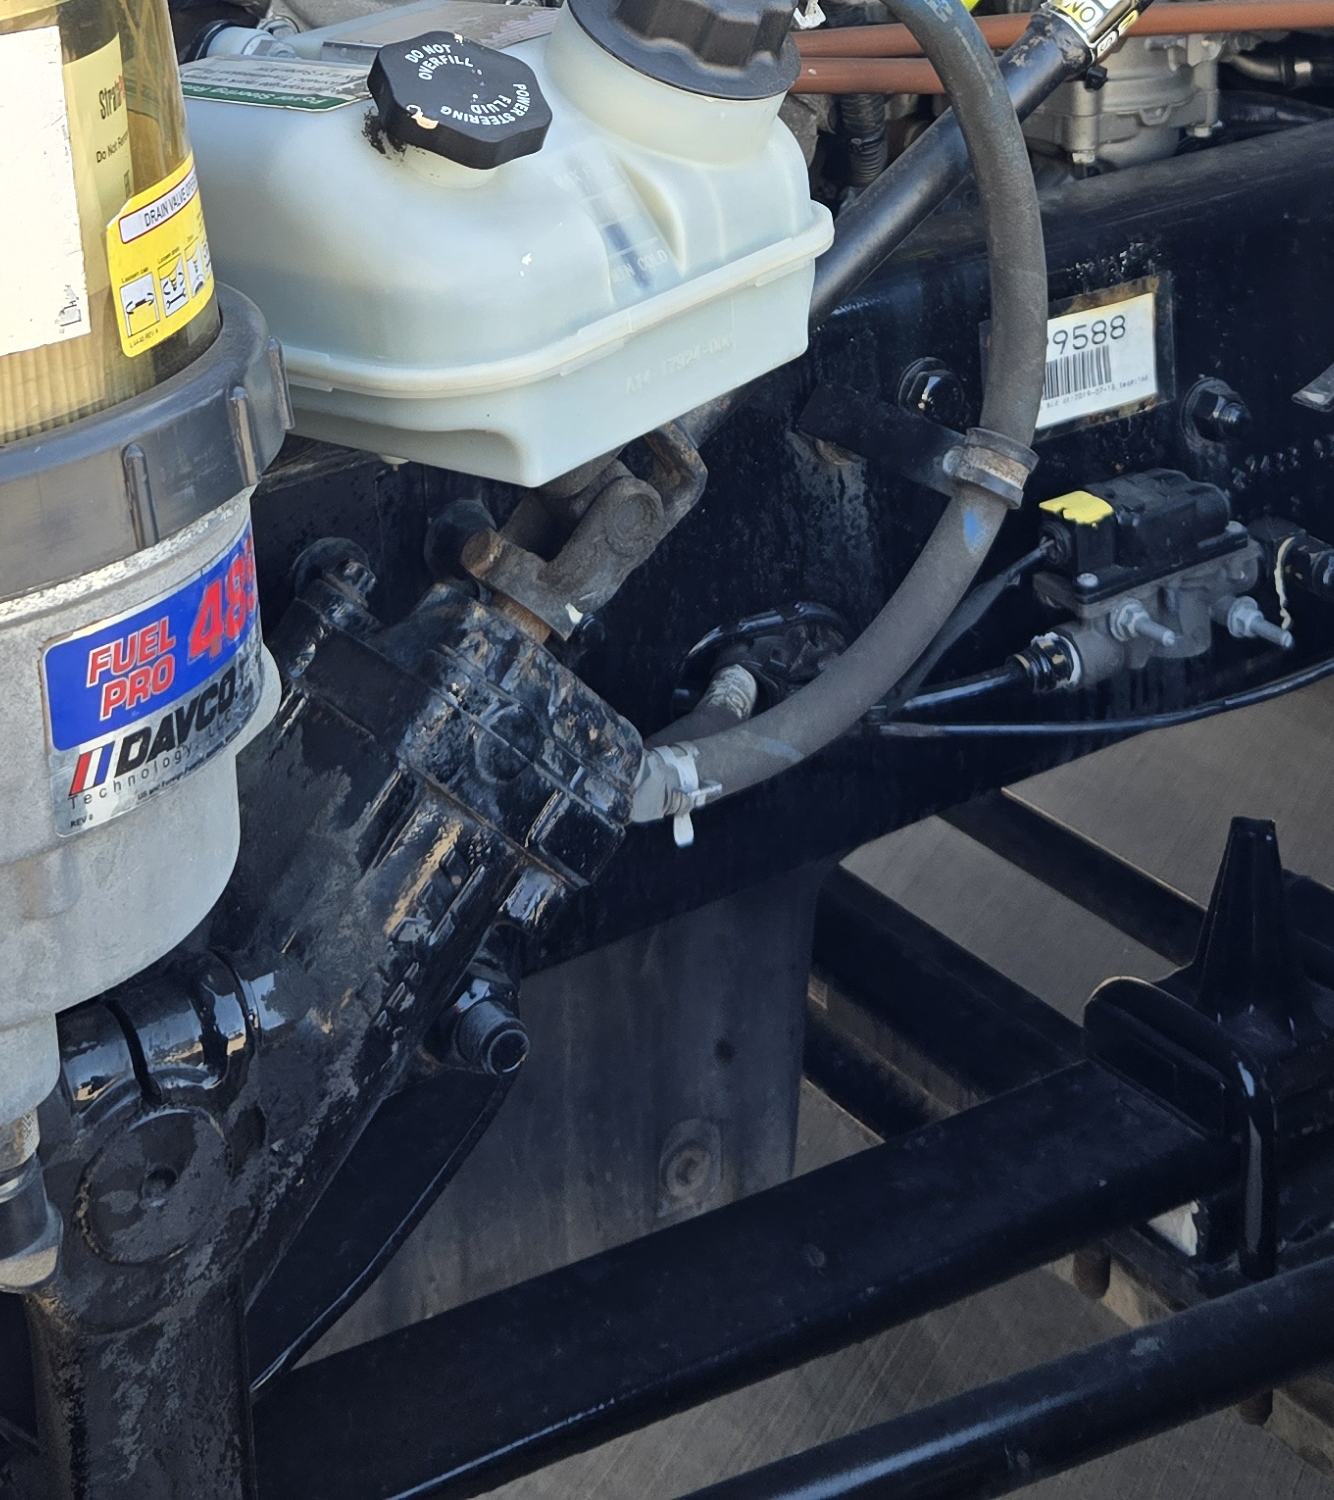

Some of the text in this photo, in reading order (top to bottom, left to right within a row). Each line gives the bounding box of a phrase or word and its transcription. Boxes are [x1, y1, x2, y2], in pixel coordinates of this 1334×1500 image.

[405, 43, 452, 64] DO NOT
[419, 55, 474, 80] OVERFILL
[440, 83, 530, 125] POWER STEERING
[471, 95, 512, 114] FLUID
[96, 150, 107, 163] Do
[144, 200, 169, 227] DRAIN
[169, 188, 187, 211] VALVE
[86, 616, 175, 687] FUEL
[100, 655, 175, 721] PRO
[115, 665, 236, 778] DAVCO
[70, 815, 87, 828] REV
